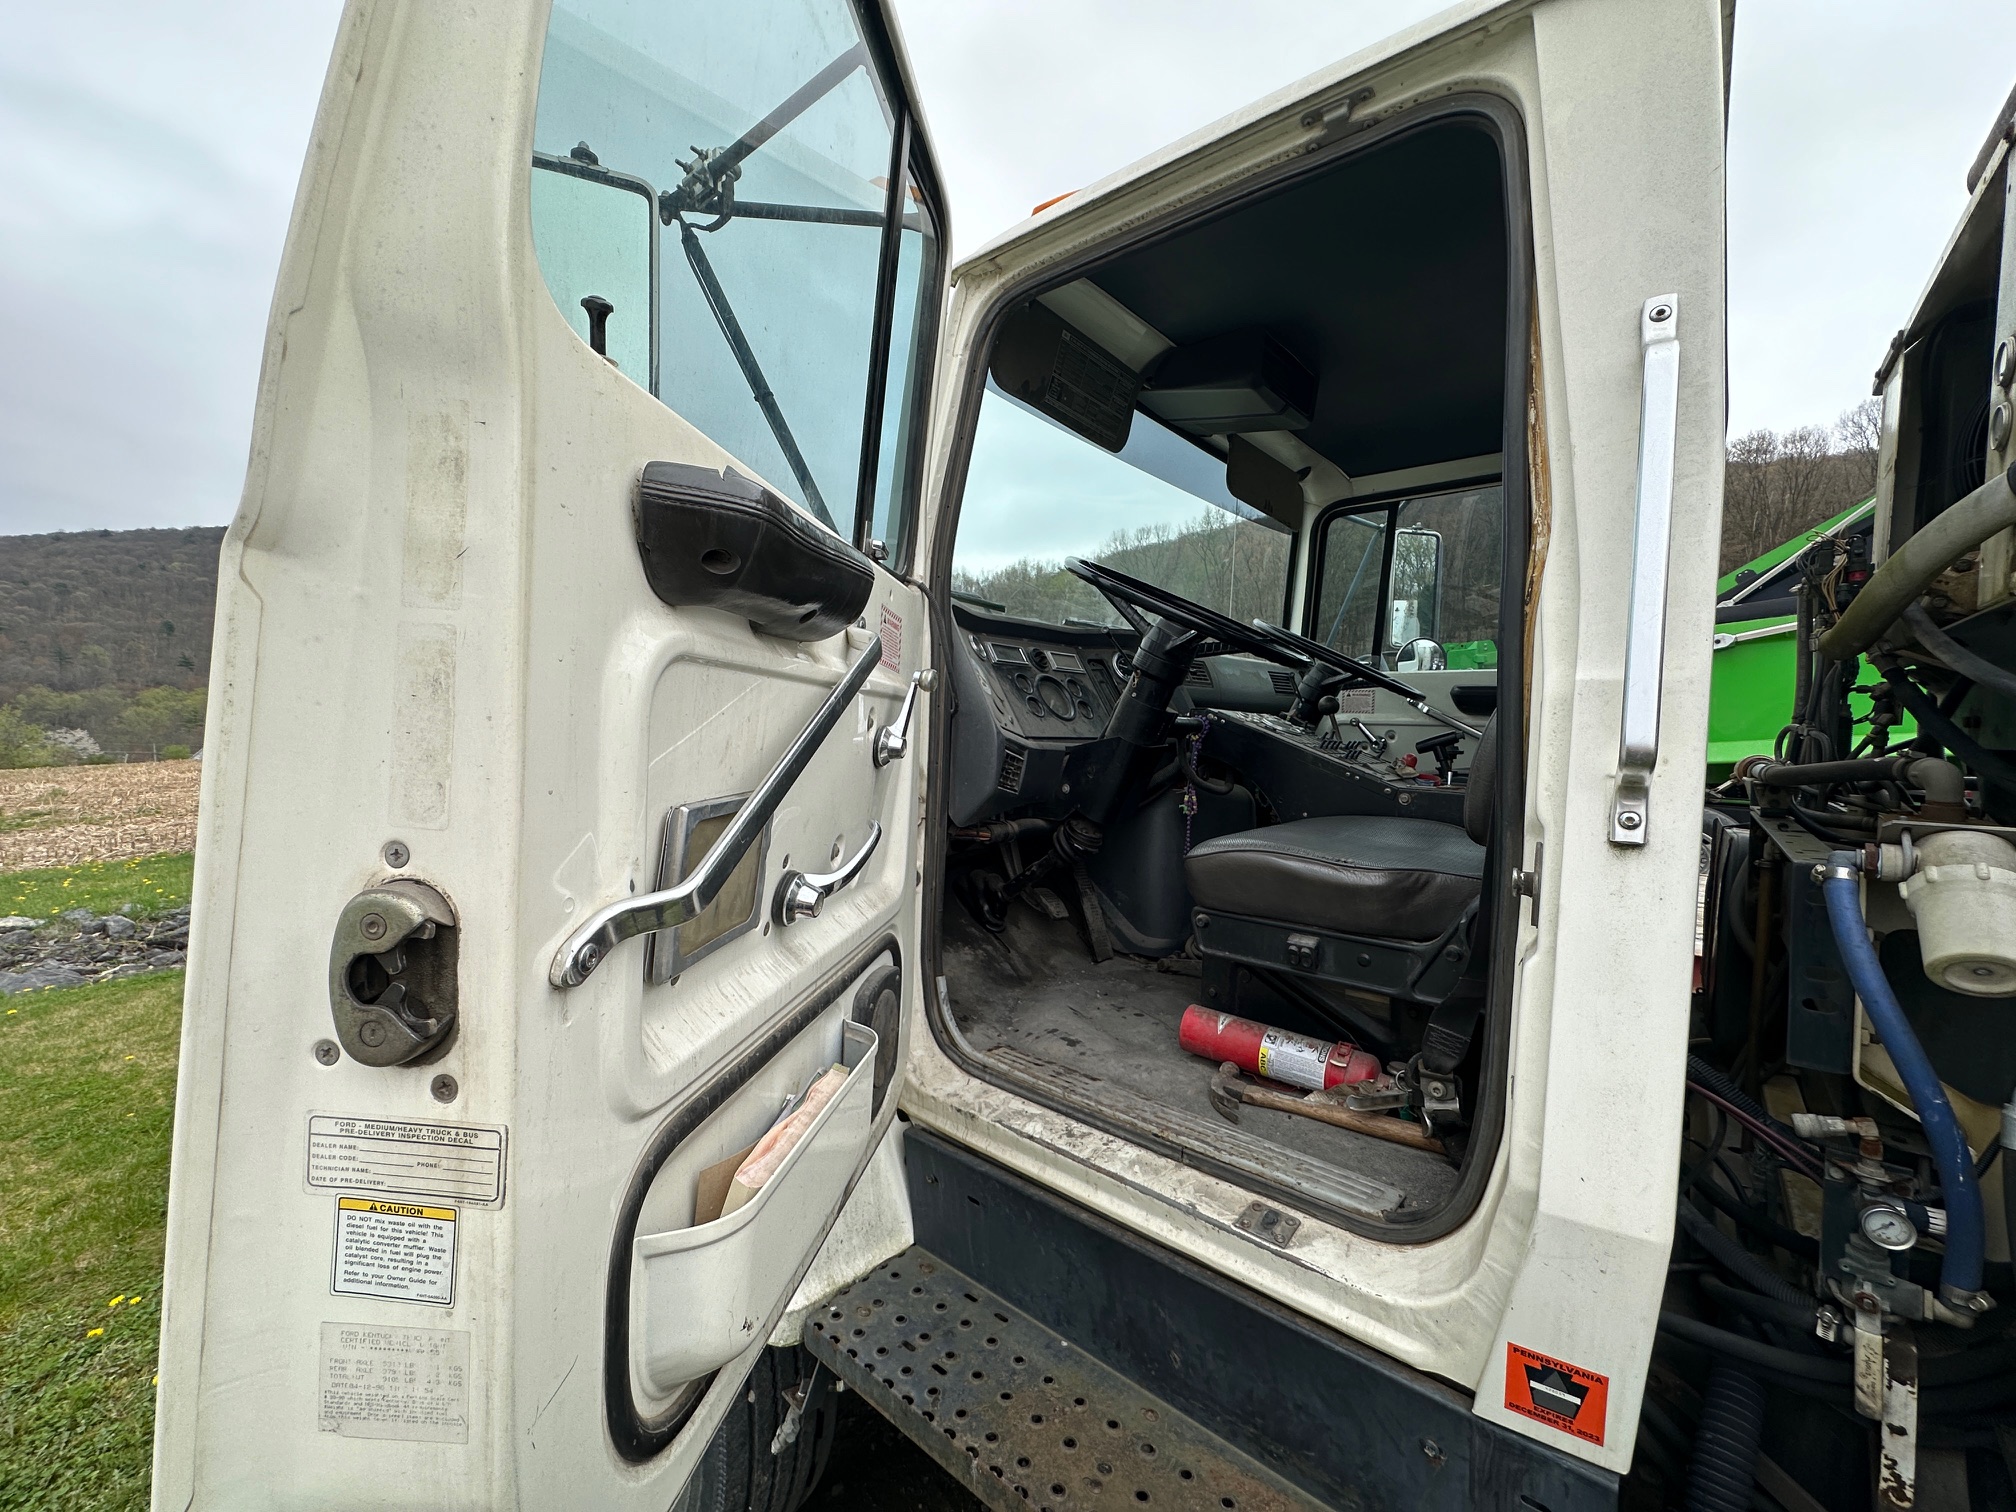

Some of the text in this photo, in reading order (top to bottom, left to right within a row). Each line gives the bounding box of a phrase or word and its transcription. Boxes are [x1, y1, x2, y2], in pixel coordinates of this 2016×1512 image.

[365, 1123, 423, 1133] MEDIUM/HEAVY
[340, 1128, 473, 1144] PRE-DELIVERY INSPECTION DECAL
[312, 1164, 350, 1172] TECHNICIAN
[340, 1178, 386, 1187] PRE-DELIVERY:
[379, 1204, 424, 1216] CAUTION
[378, 1233, 405, 1242] equipped
[408, 1235, 420, 1243] with
[431, 1231, 444, 1239] This
[345, 1237, 370, 1245] catalytic
[373, 1240, 401, 1248] converter
[428, 1246, 447, 1254] Waste
[345, 1252, 368, 1260] catalyst
[387, 1257, 414, 1266] resulting
[417, 1251, 430, 1260] plug
[344, 1260, 375, 1268] significant
[401, 1266, 422, 1274] engine
[409, 1277, 426, 1285] Guide
[1513, 1346, 1604, 1385] PENNSYLVANIA
[1509, 1401, 1560, 1426] DECEMBER
[1577, 1428, 1601, 1441] 2023
[1534, 1405, 1574, 1425] EXPIRES
